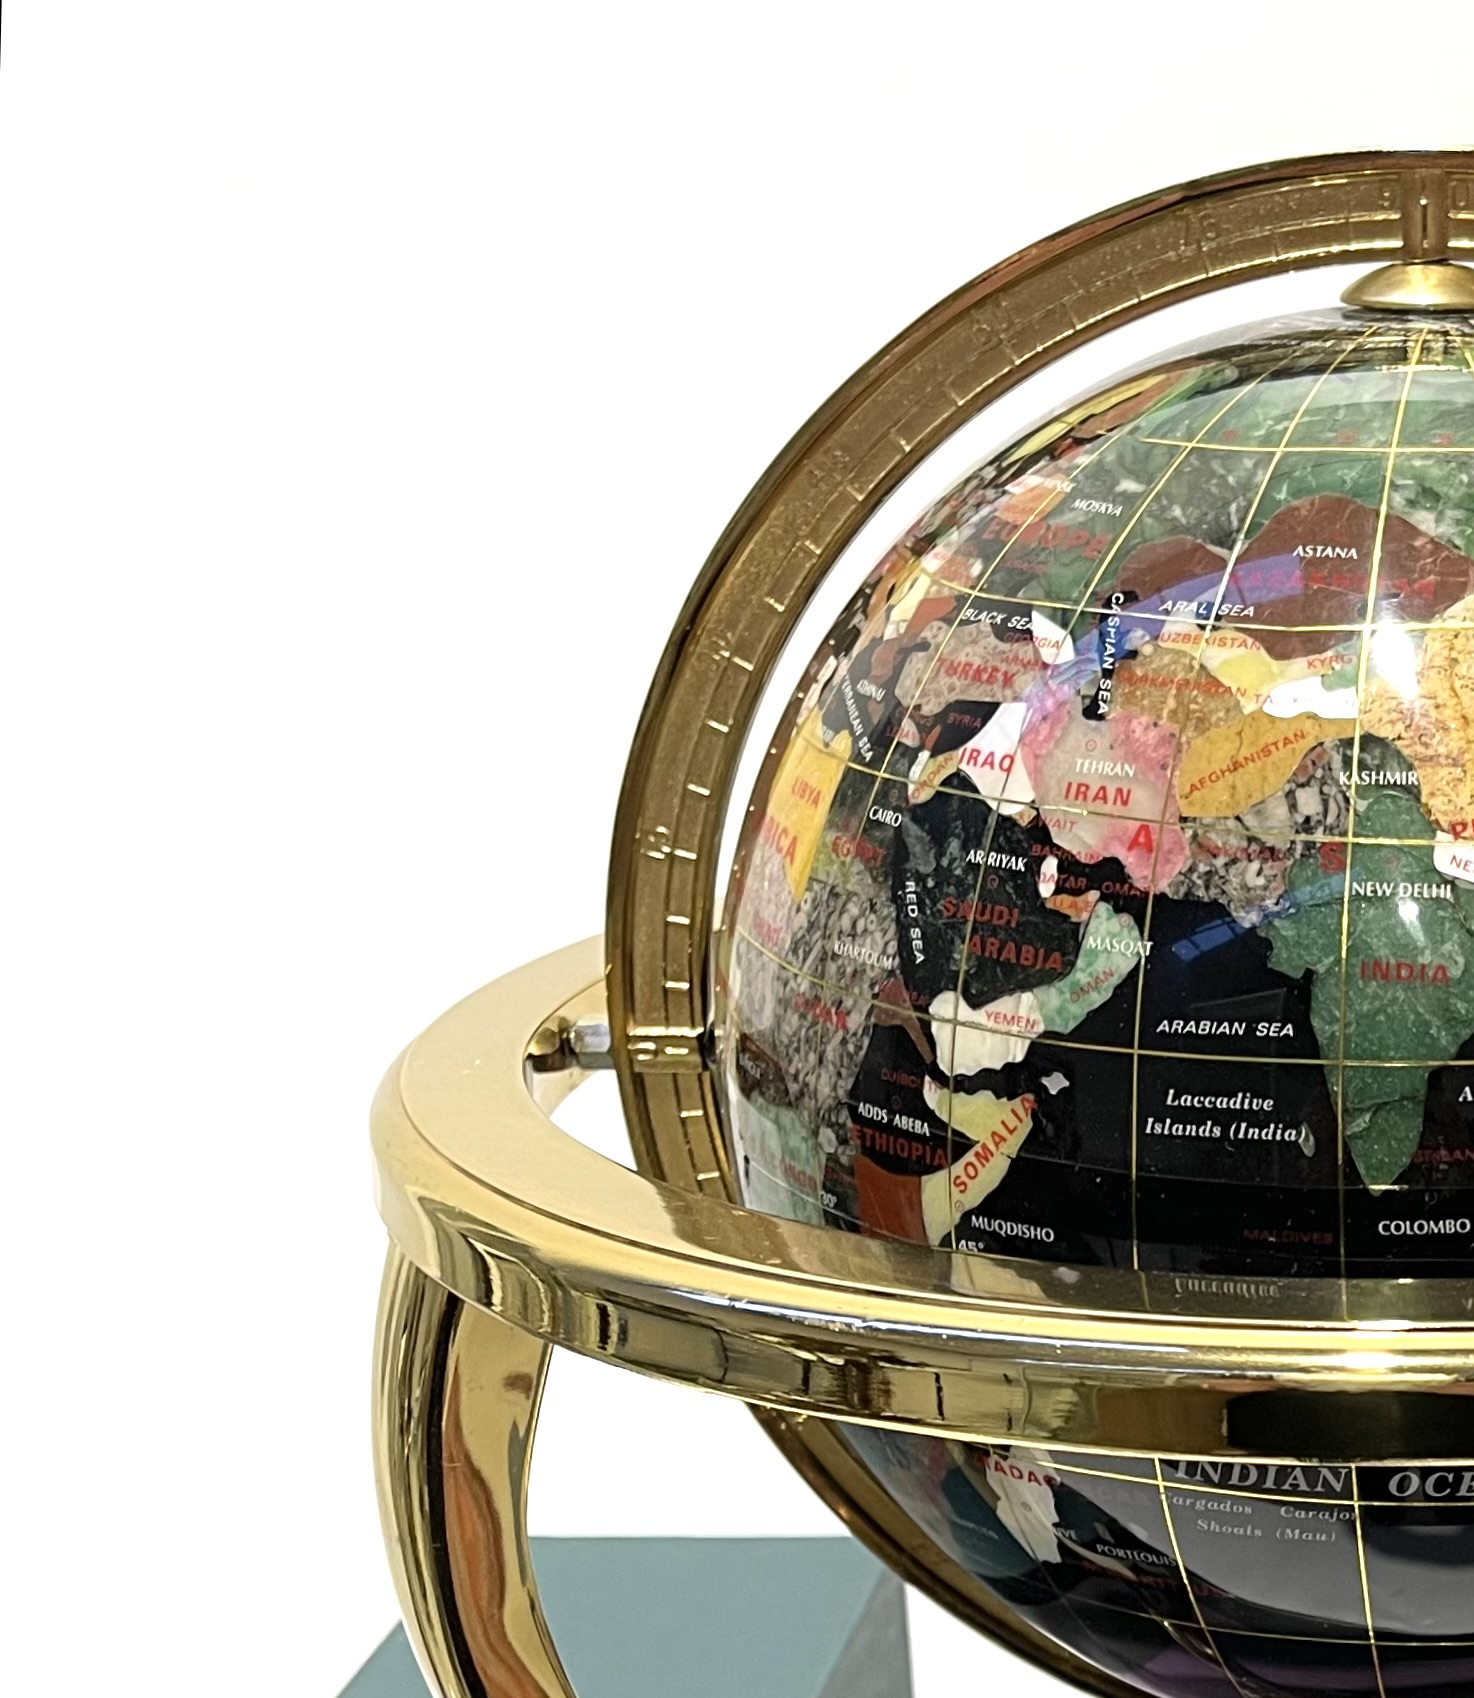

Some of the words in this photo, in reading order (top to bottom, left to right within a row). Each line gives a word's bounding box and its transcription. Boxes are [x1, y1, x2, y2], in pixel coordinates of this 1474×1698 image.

[1070, 498, 1124, 517] MOSKVA
[982, 516, 1113, 560] EUROPE
[1292, 544, 1358, 561] ASTANA
[961, 607, 1004, 626] BLACK
[1006, 614, 1035, 632] SEA
[1158, 598, 1208, 616] ARAL
[1217, 602, 1256, 619] SEA
[1100, 592, 1125, 671] CASPIAN
[933, 657, 1018, 688] TURKEY
[1097, 678, 1113, 716] SEA
[946, 711, 984, 730] SYRIA
[959, 746, 1016, 774] IRAQ
[1074, 757, 1136, 778] TEHRAN
[1186, 729, 1308, 797] AFGHANISTAN
[1338, 770, 1420, 787] KASHMIR
[1064, 780, 1132, 807] IRAN
[868, 805, 903, 828] CAIRO
[904, 880, 919, 918] RED
[1351, 881, 1395, 897] NEW
[1397, 882, 1452, 900] DELHI
[939, 895, 1020, 929] SAUDI
[910, 927, 926, 966] SEA
[968, 933, 1064, 973] ARABIA
[1086, 935, 1154, 959] MASQAT
[1069, 966, 1116, 1004] OMAN
[1359, 959, 1451, 985] INDIA
[984, 1010, 1037, 1031] YEMEN
[1156, 1018, 1246, 1037] ARABIAN
[1255, 1022, 1295, 1038] SEA
[1165, 1088, 1275, 1112] Laccadive
[857, 1101, 889, 1124] ADDS
[892, 1113, 931, 1137] ABEBA
[1144, 1116, 1222, 1139] Islands
[1228, 1120, 1308, 1143] (India)
[852, 1123, 950, 1169] ETHIOPIA
[952, 1091, 1039, 1196] SOMALIA
[970, 1213, 1056, 1243] MUQDISHO
[1377, 1218, 1472, 1236] COLOMBO
[1173, 1459, 1353, 1495] INDIAN
[1196, 1516, 1264, 1539] Shoals
[1276, 1523, 1338, 1544] (Mau)
